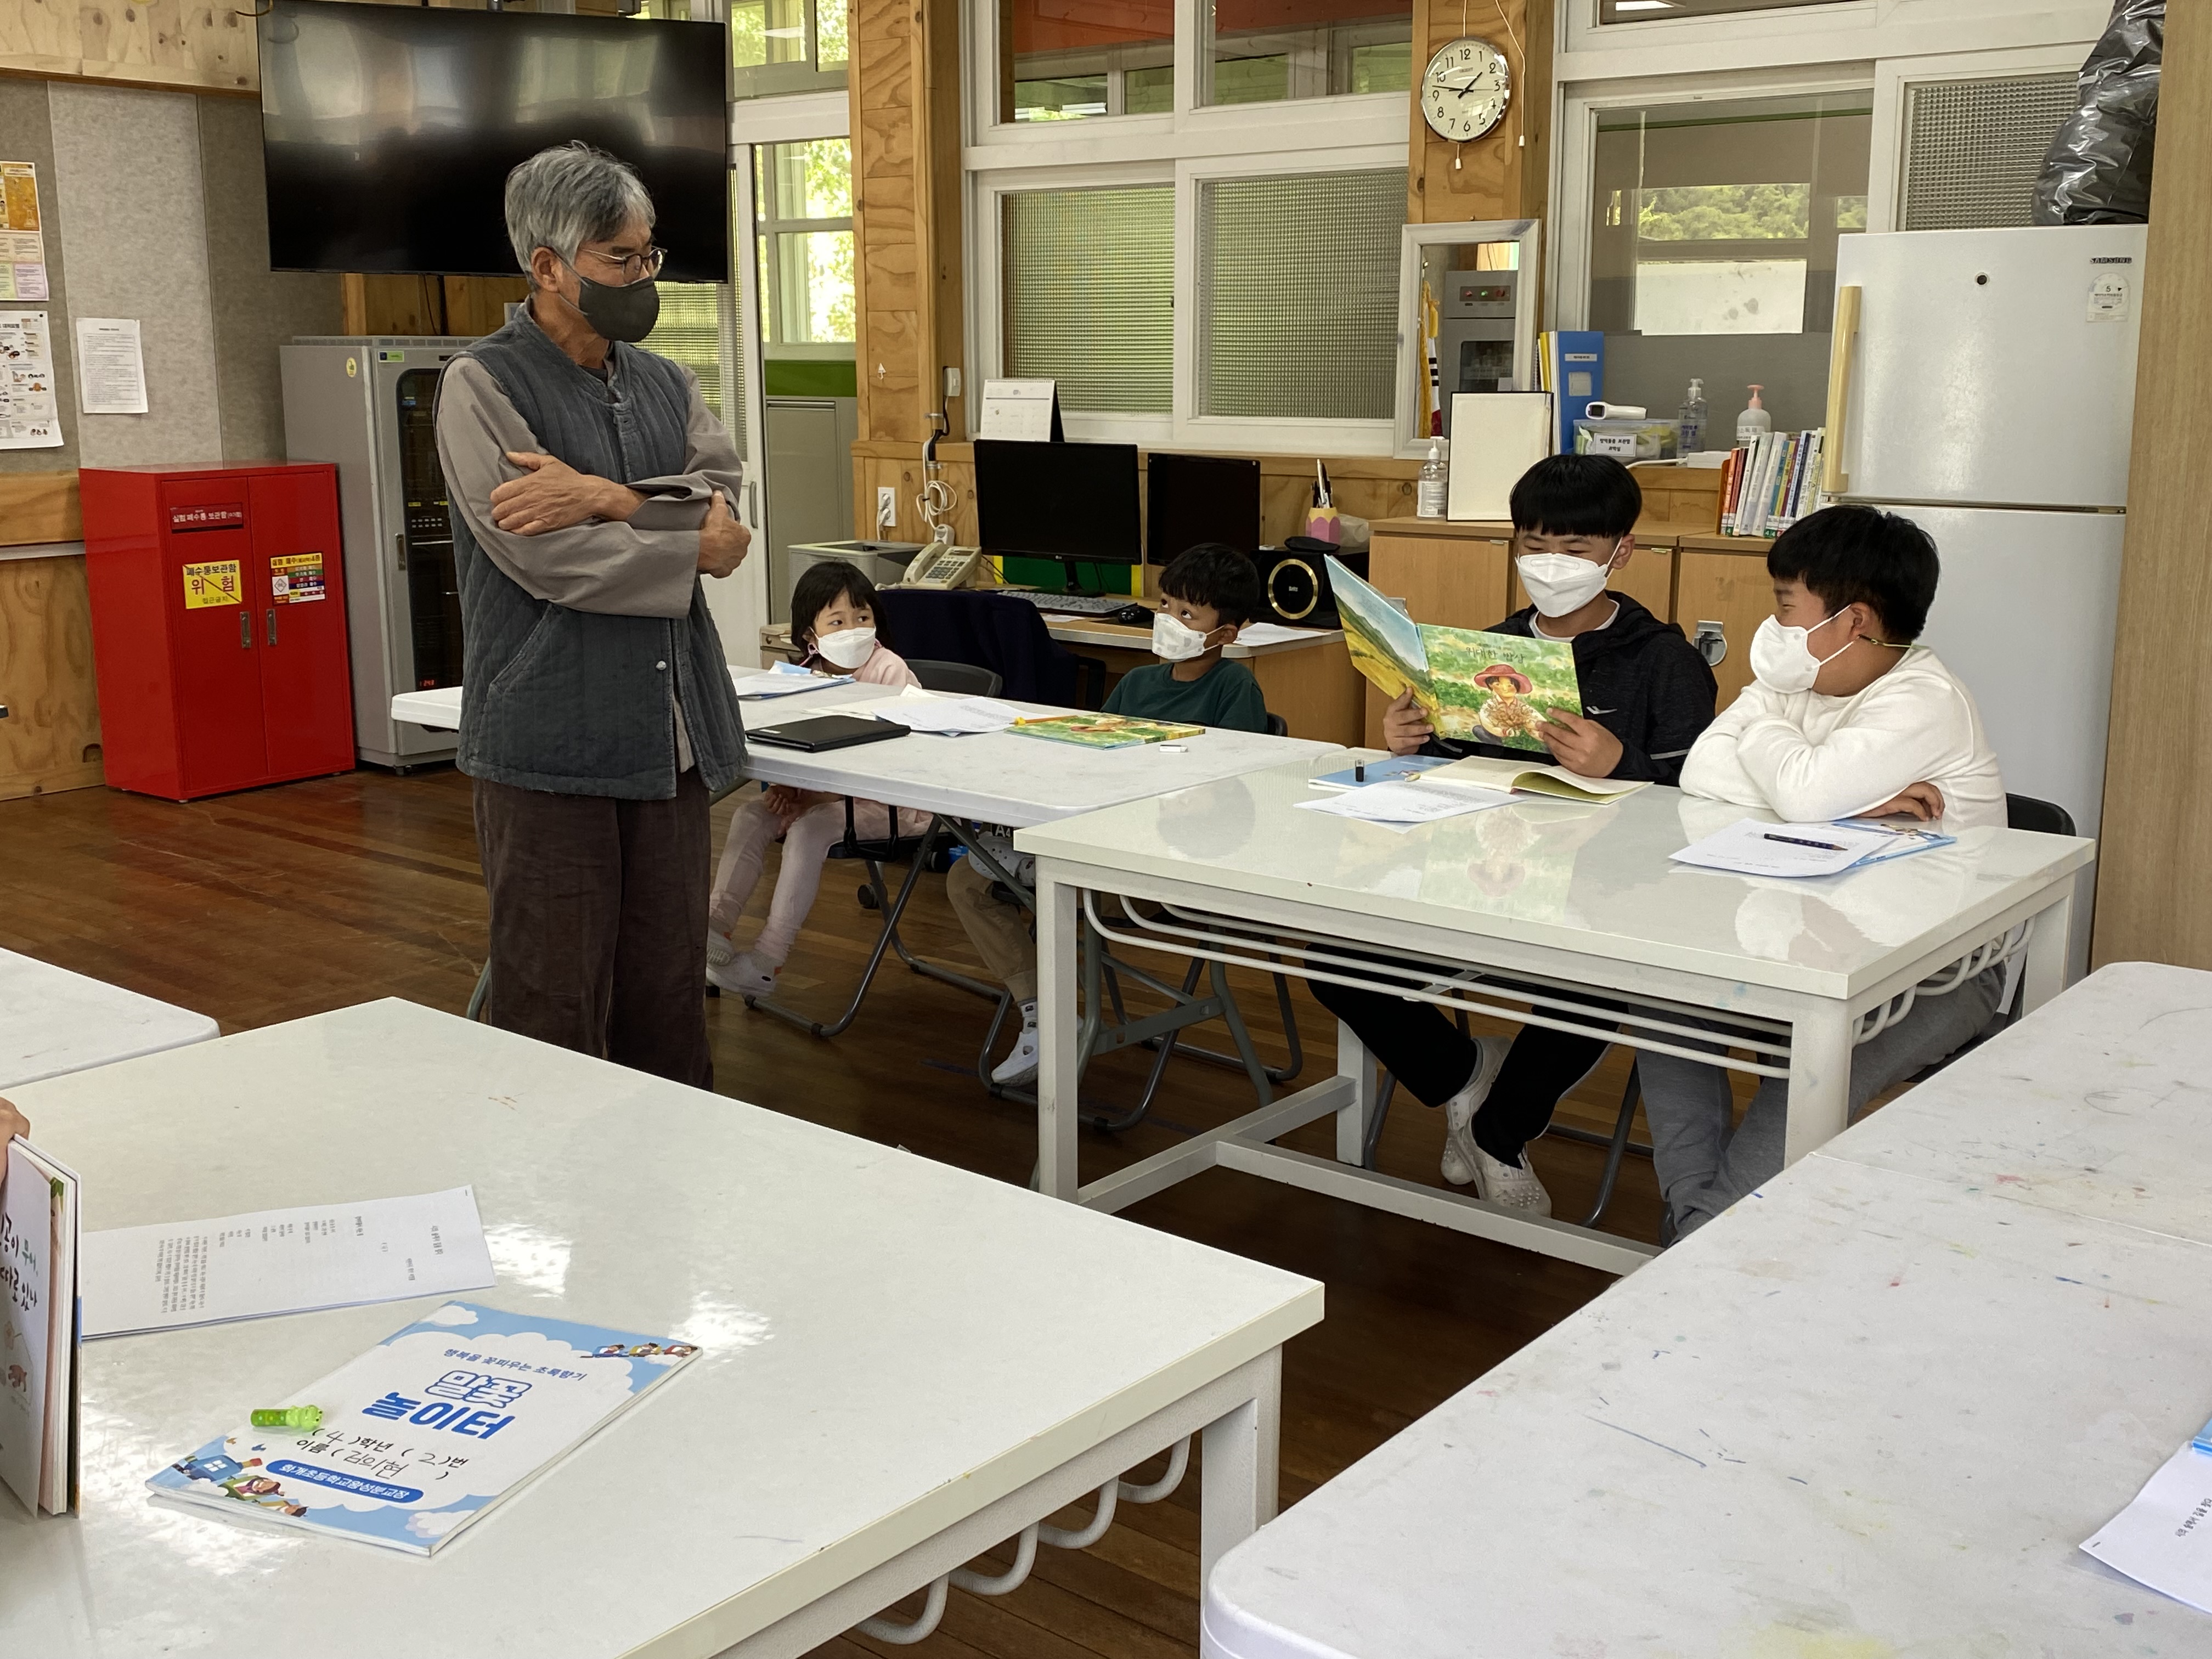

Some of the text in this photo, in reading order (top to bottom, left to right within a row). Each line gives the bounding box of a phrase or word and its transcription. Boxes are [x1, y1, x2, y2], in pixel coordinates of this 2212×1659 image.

[1460, 48, 1471, 61] 12
[1479, 50, 1482, 62] 1
[1446, 57, 1454, 69] 11
[1489, 63, 1497, 74] 2
[1435, 71, 1446, 83] 10
[1494, 80, 1500, 92] 3
[1432, 90, 1440, 101] 9
[1491, 98, 1497, 109] 4
[1437, 106, 1444, 118] 8
[1449, 118, 1455, 130] 7
[1479, 112, 1486, 125] 5
[1463, 120, 1471, 132] 6
[443, 1348, 588, 1381] 행복을 꽃피우는 초록향기
[424, 1370, 532, 1409] 말꽃
[362, 1392, 516, 1440] 놀이터
